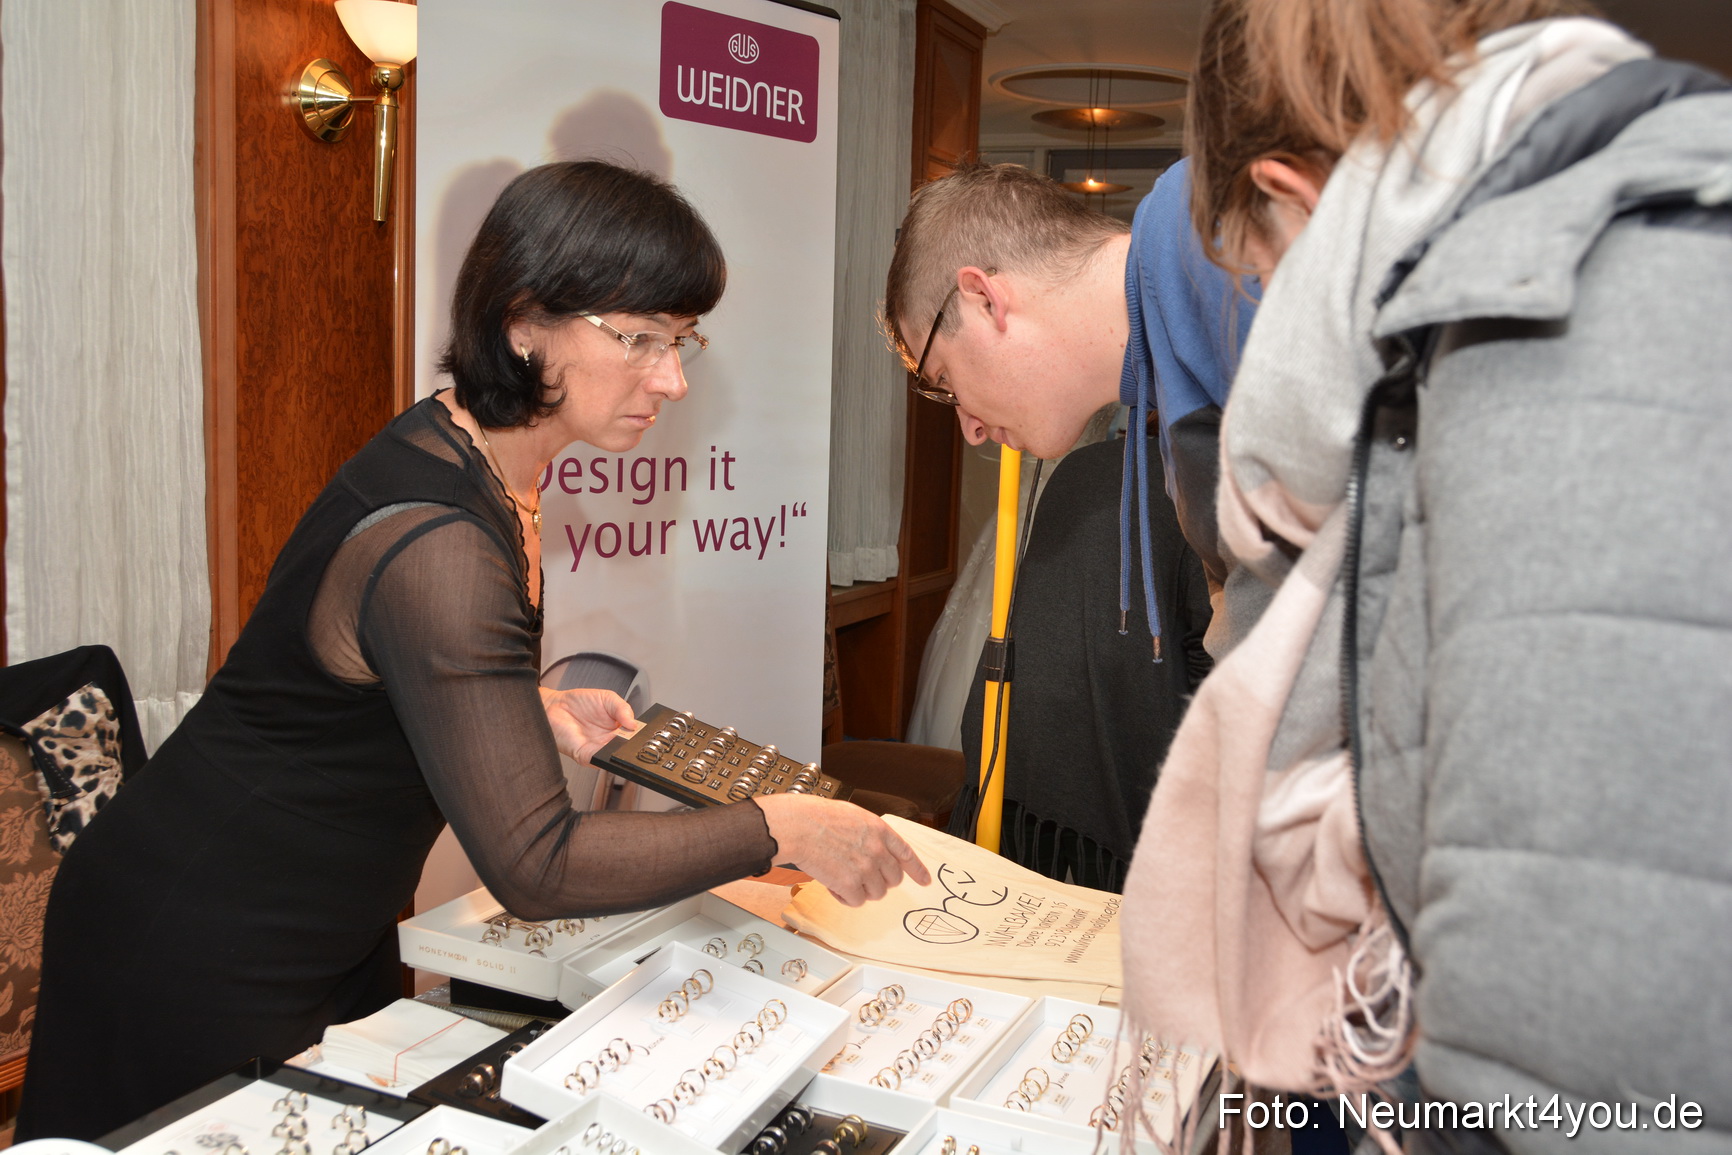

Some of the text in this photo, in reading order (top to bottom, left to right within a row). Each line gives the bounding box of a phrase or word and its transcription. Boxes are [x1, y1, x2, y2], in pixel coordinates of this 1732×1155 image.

[677, 65, 806, 125] WEIDNER
[709, 446, 736, 491] it
[564, 519, 677, 573] your
[476, 958, 505, 971] SOLID
